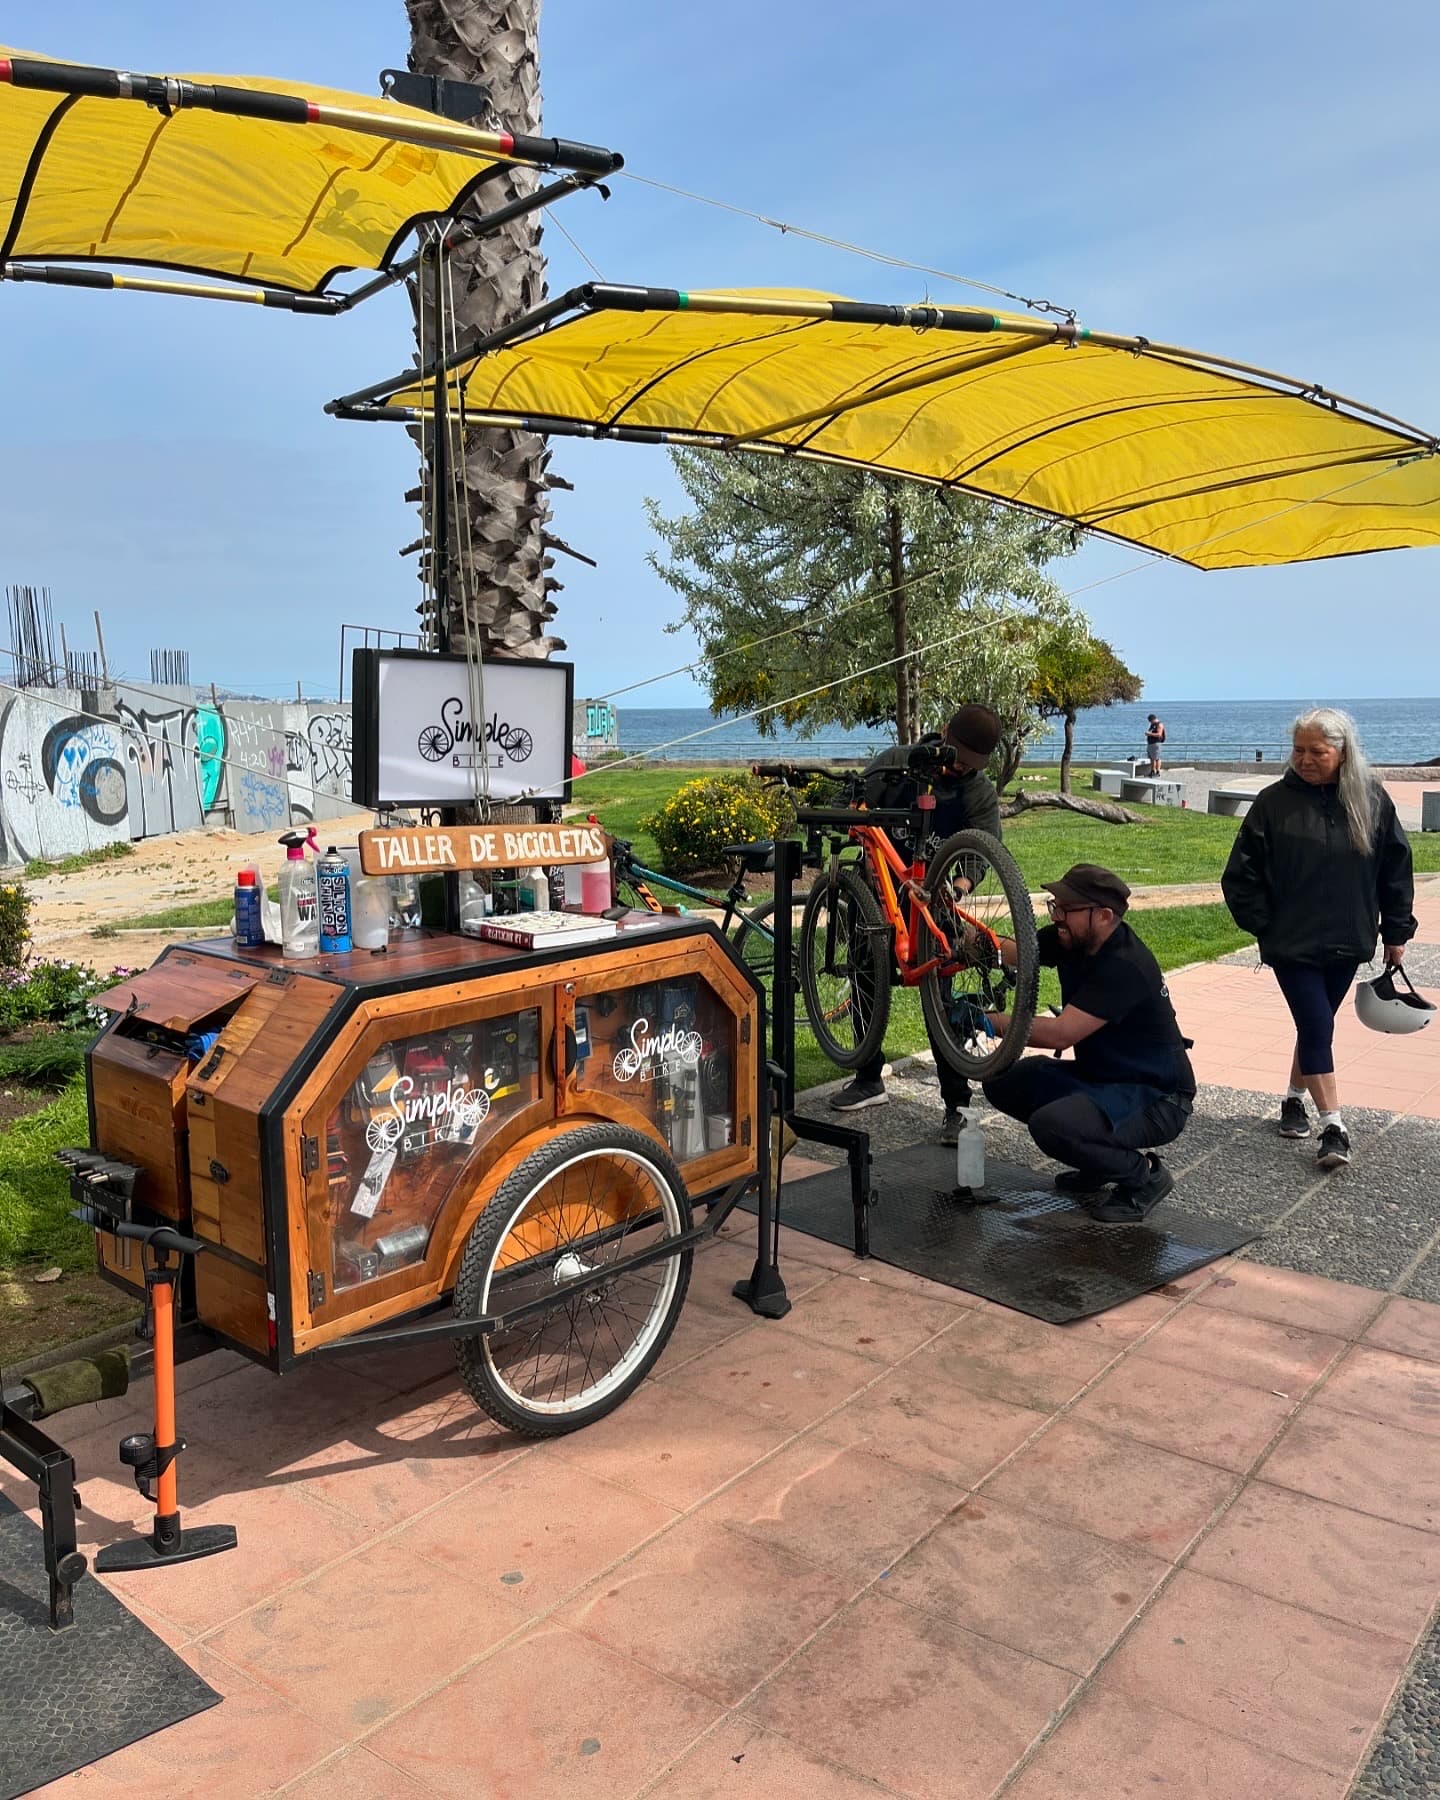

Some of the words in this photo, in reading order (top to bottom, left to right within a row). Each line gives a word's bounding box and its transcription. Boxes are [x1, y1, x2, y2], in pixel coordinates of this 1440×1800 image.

[432, 697, 522, 754] Simple
[371, 835, 457, 868] TALLER
[469, 833, 499, 863] DE
[624, 1018, 695, 1073] Simple
[639, 1059, 681, 1081] BIKE
[383, 1076, 476, 1141] Simple
[403, 1126, 461, 1151] BIKE
